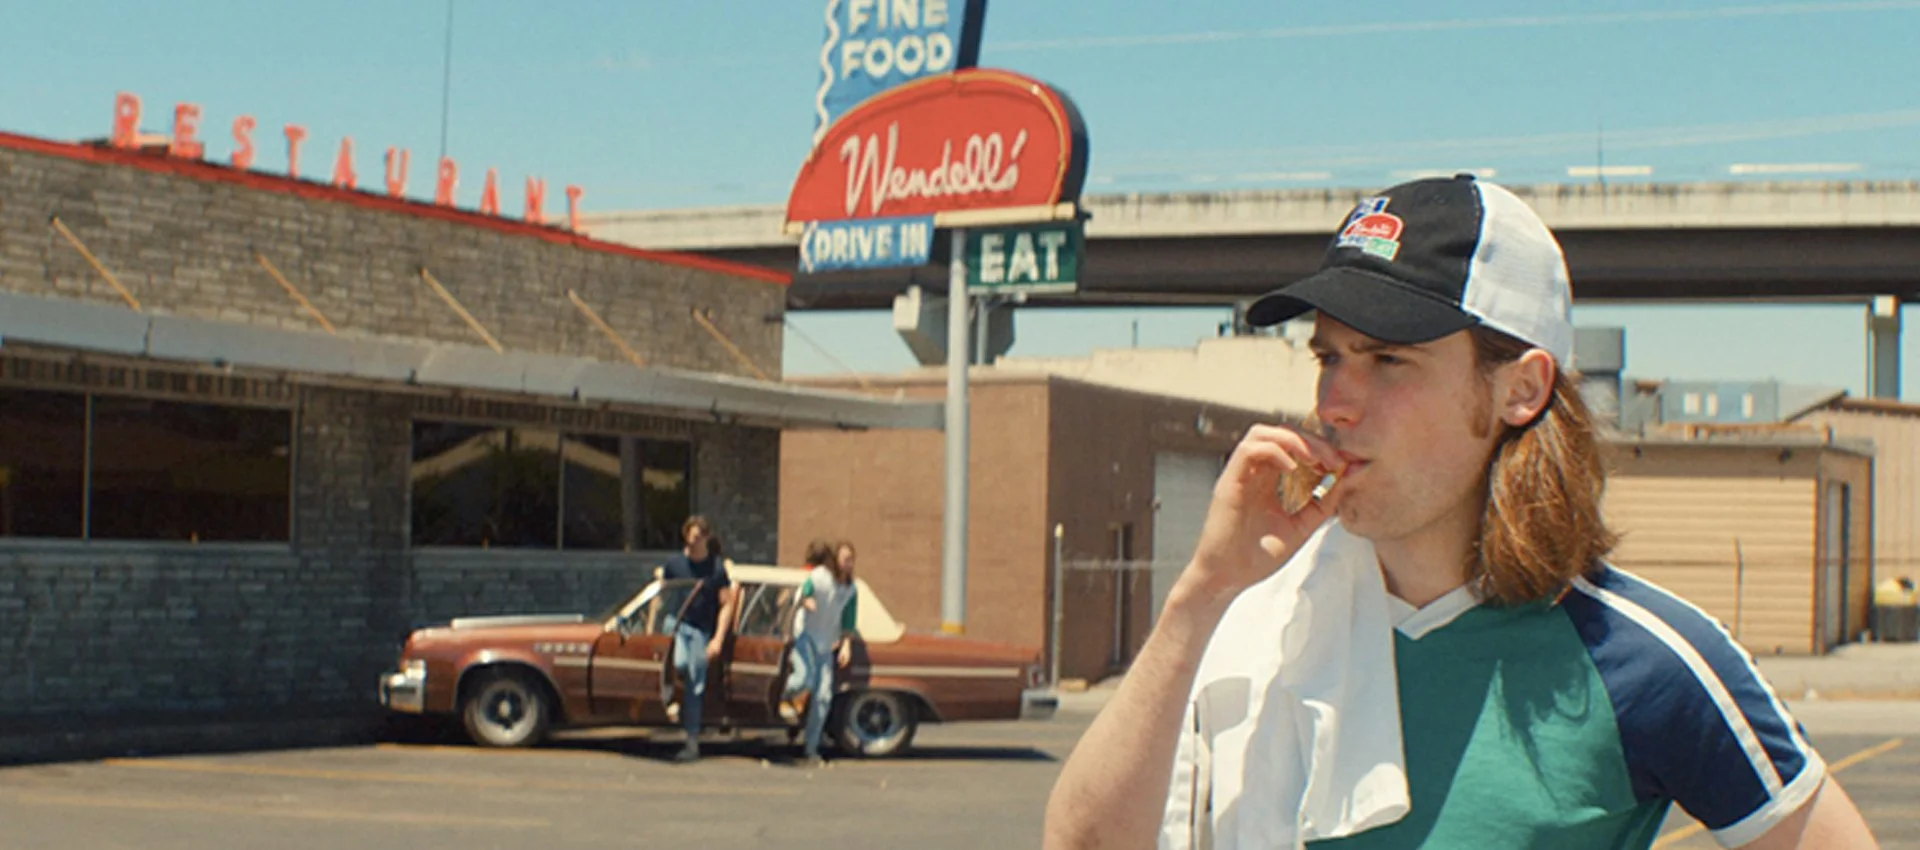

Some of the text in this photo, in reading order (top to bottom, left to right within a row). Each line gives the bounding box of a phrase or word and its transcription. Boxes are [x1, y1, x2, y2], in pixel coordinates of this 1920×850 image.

[848, 0, 948, 33] FINE
[841, 33, 953, 80] FOOD
[112, 91, 584, 232] RESTAURANT
[840, 121, 1027, 216] Wendell's
[814, 223, 927, 263] DRIVE IN
[979, 231, 1066, 283] EAT
